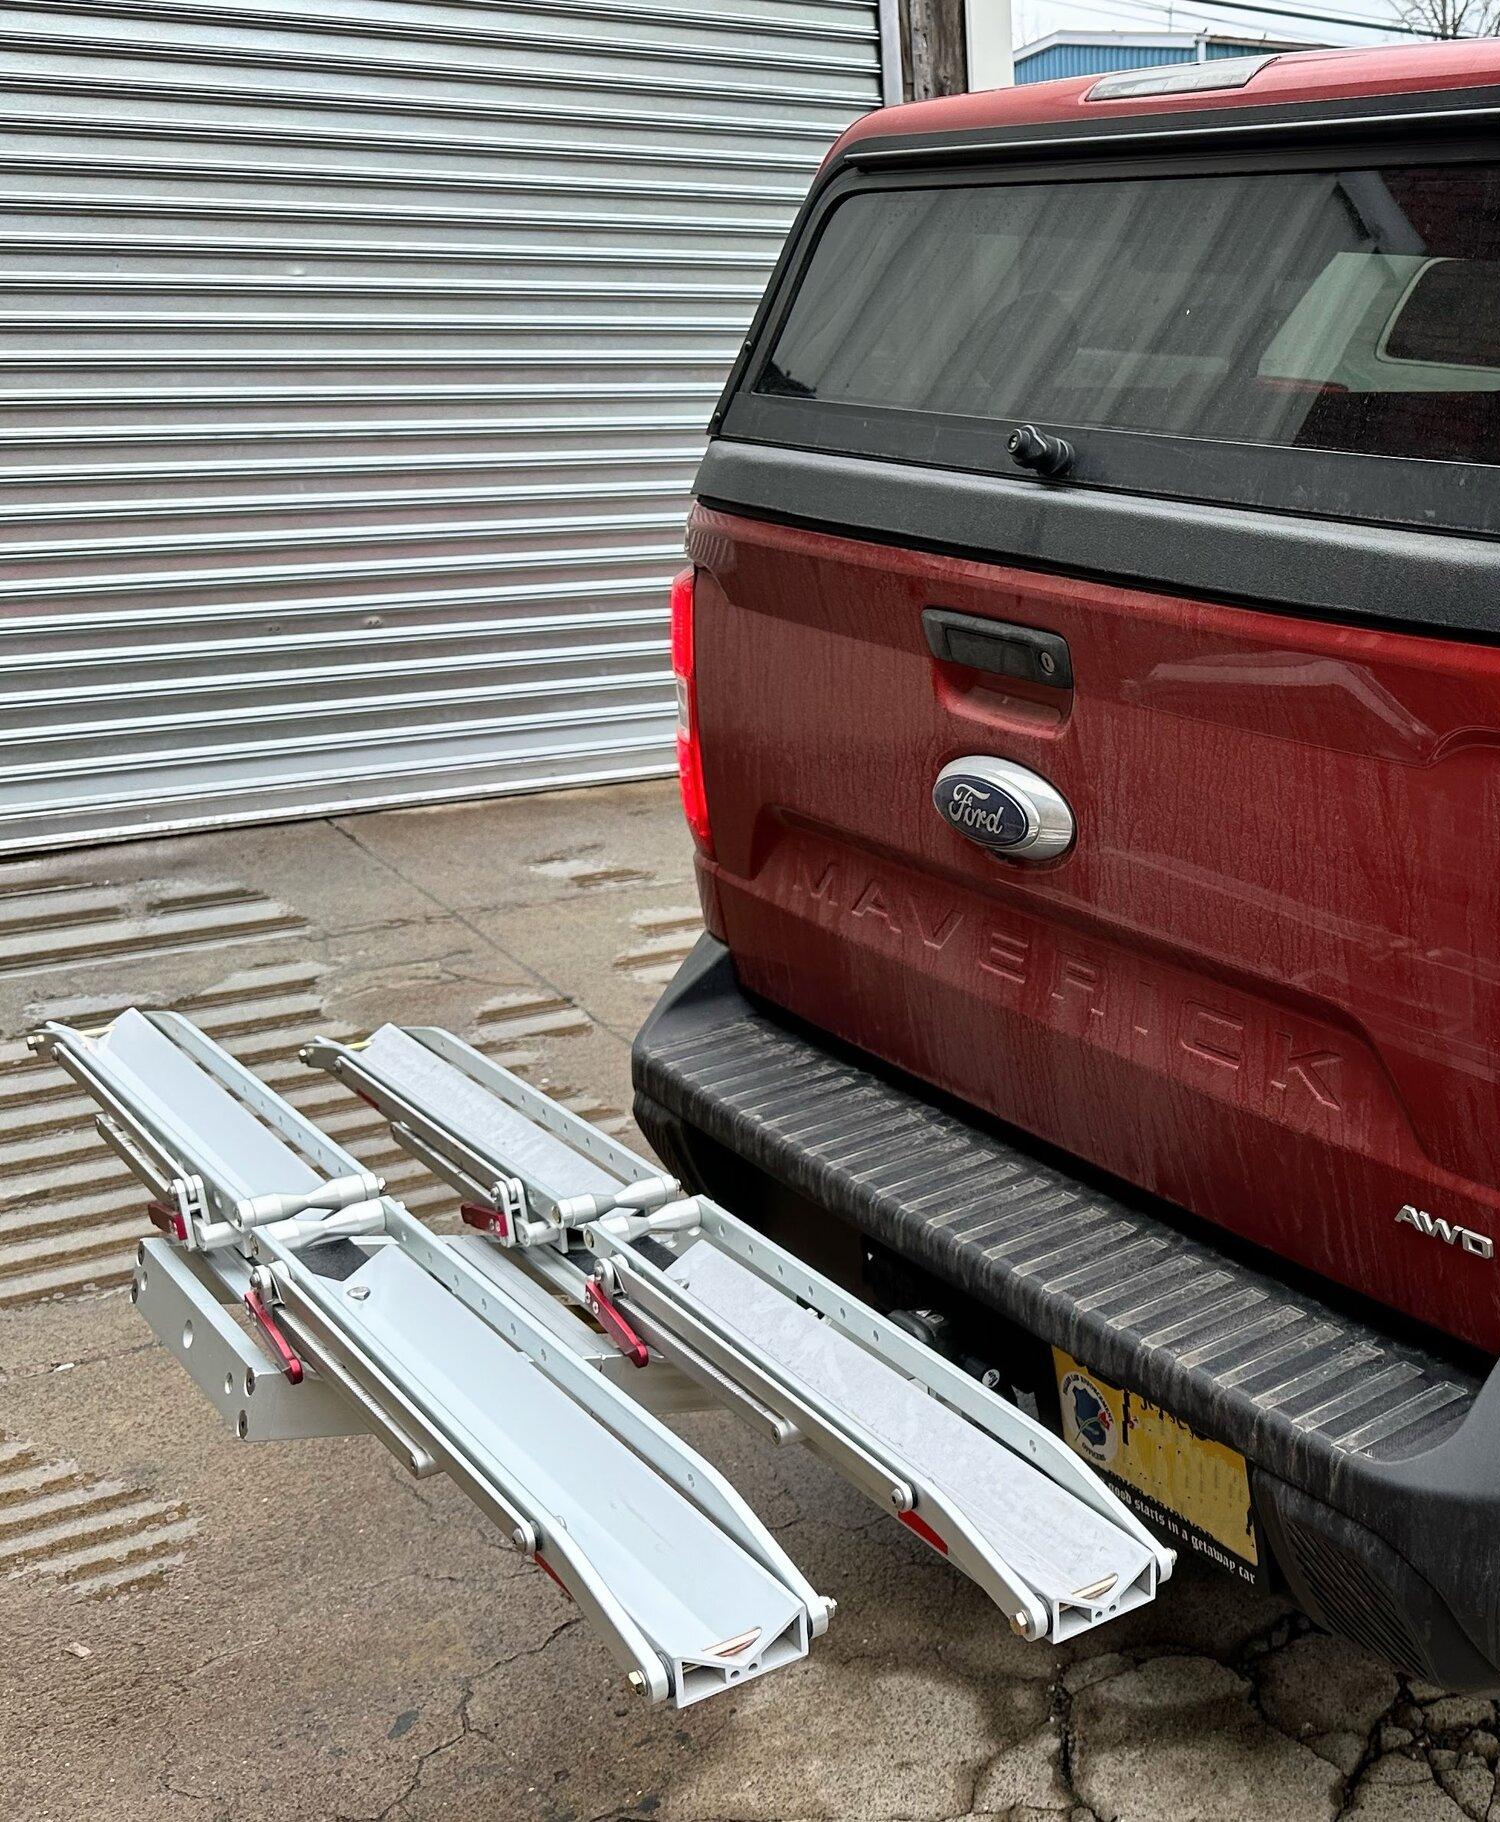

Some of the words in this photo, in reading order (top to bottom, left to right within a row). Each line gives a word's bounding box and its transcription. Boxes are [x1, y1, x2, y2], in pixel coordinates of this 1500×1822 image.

[947, 782, 1004, 835] Ford
[792, 860, 1343, 1111] MAVERICK
[1394, 1204, 1495, 1259] AWD
[1134, 1499, 1166, 1527] starts
[1167, 1517, 1180, 1537] in
[1181, 1529, 1189, 1542] a
[1191, 1535, 1237, 1575] getaway
[1238, 1565, 1256, 1585] car
